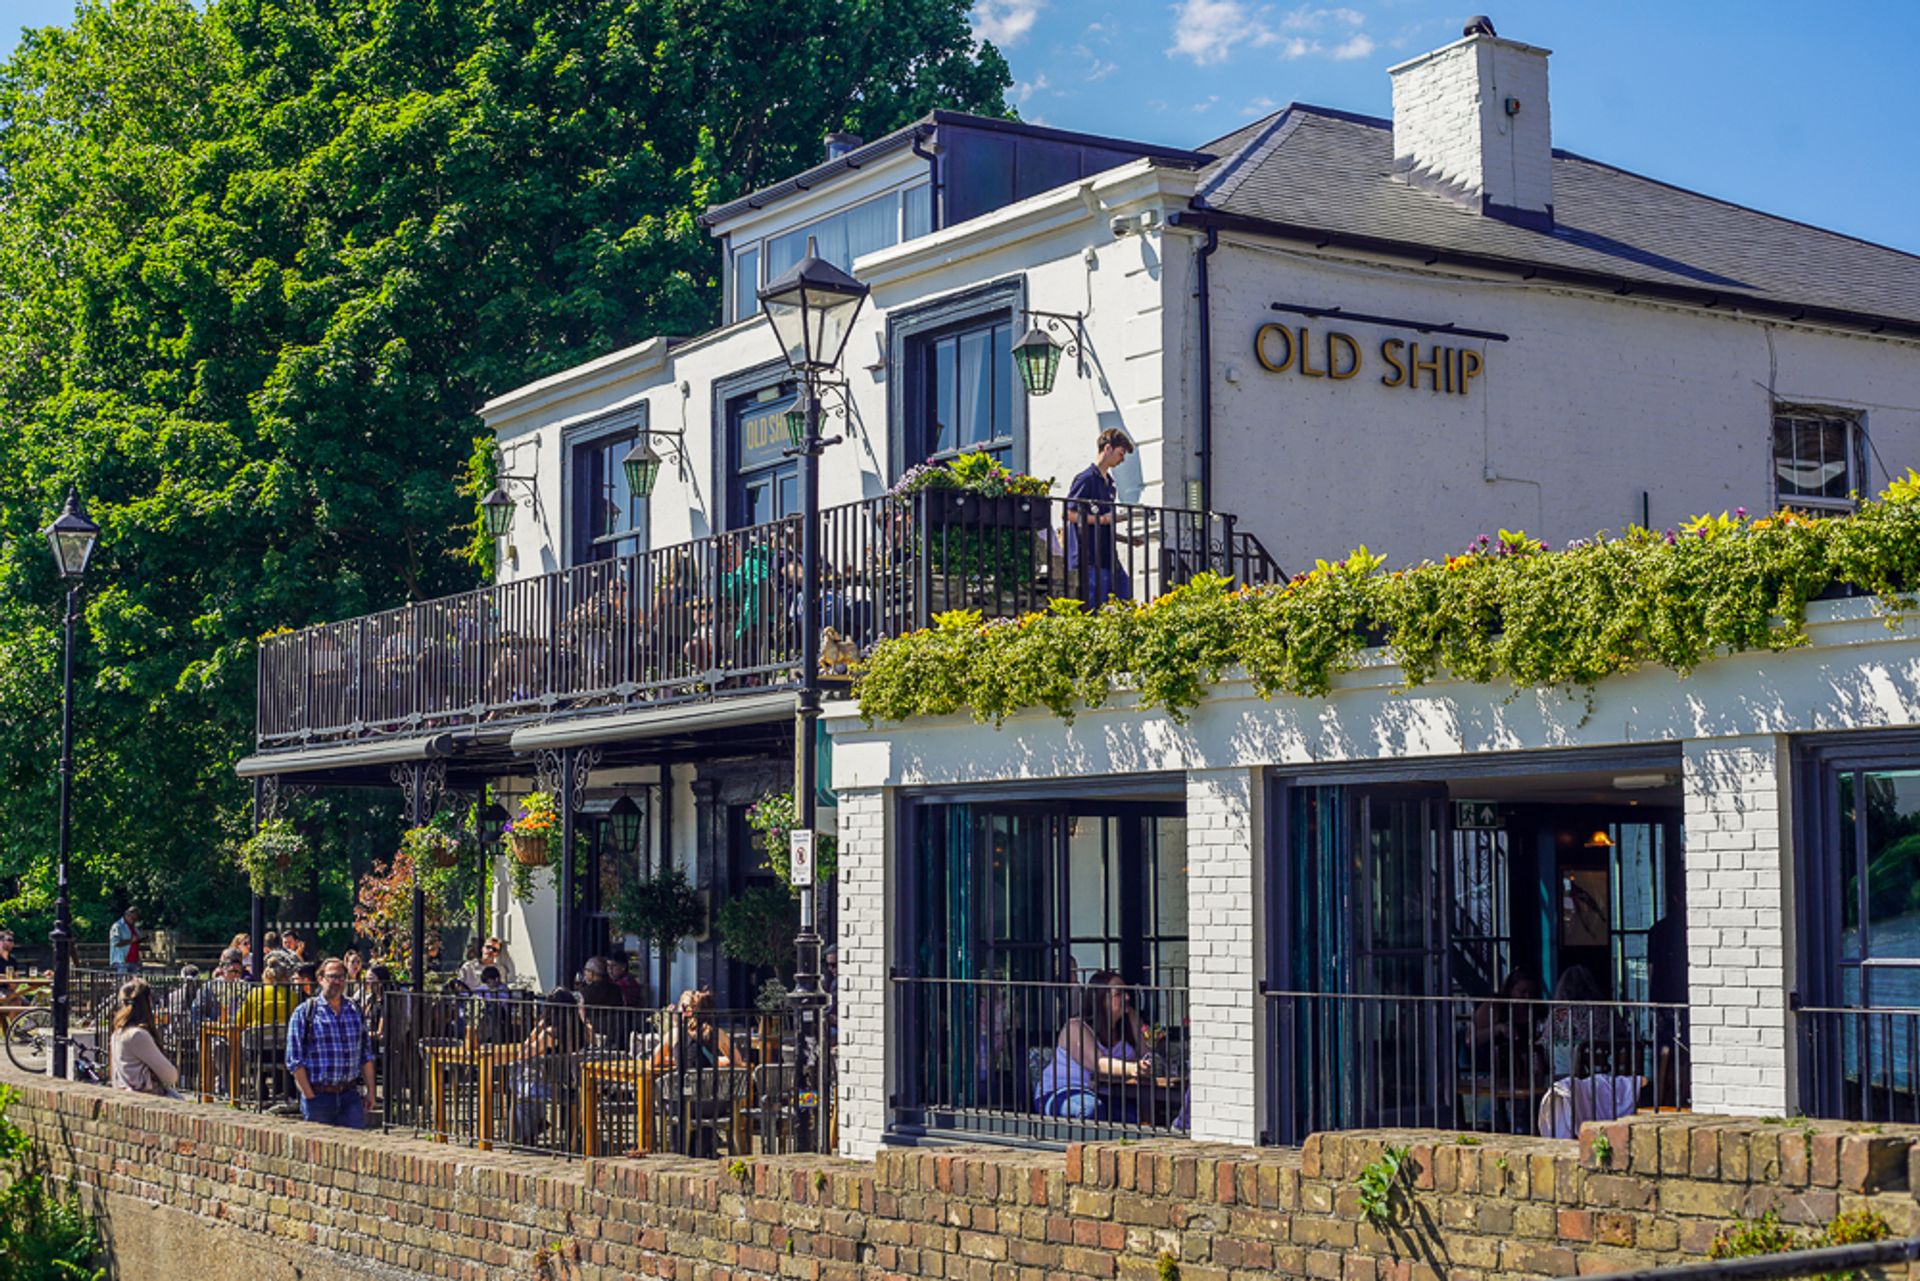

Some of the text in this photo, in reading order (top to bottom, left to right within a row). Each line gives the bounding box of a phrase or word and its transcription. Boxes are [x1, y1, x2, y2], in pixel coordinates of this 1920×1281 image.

[1255, 322, 1484, 394] OLD SHIP
[747, 416, 768, 450] OLD
